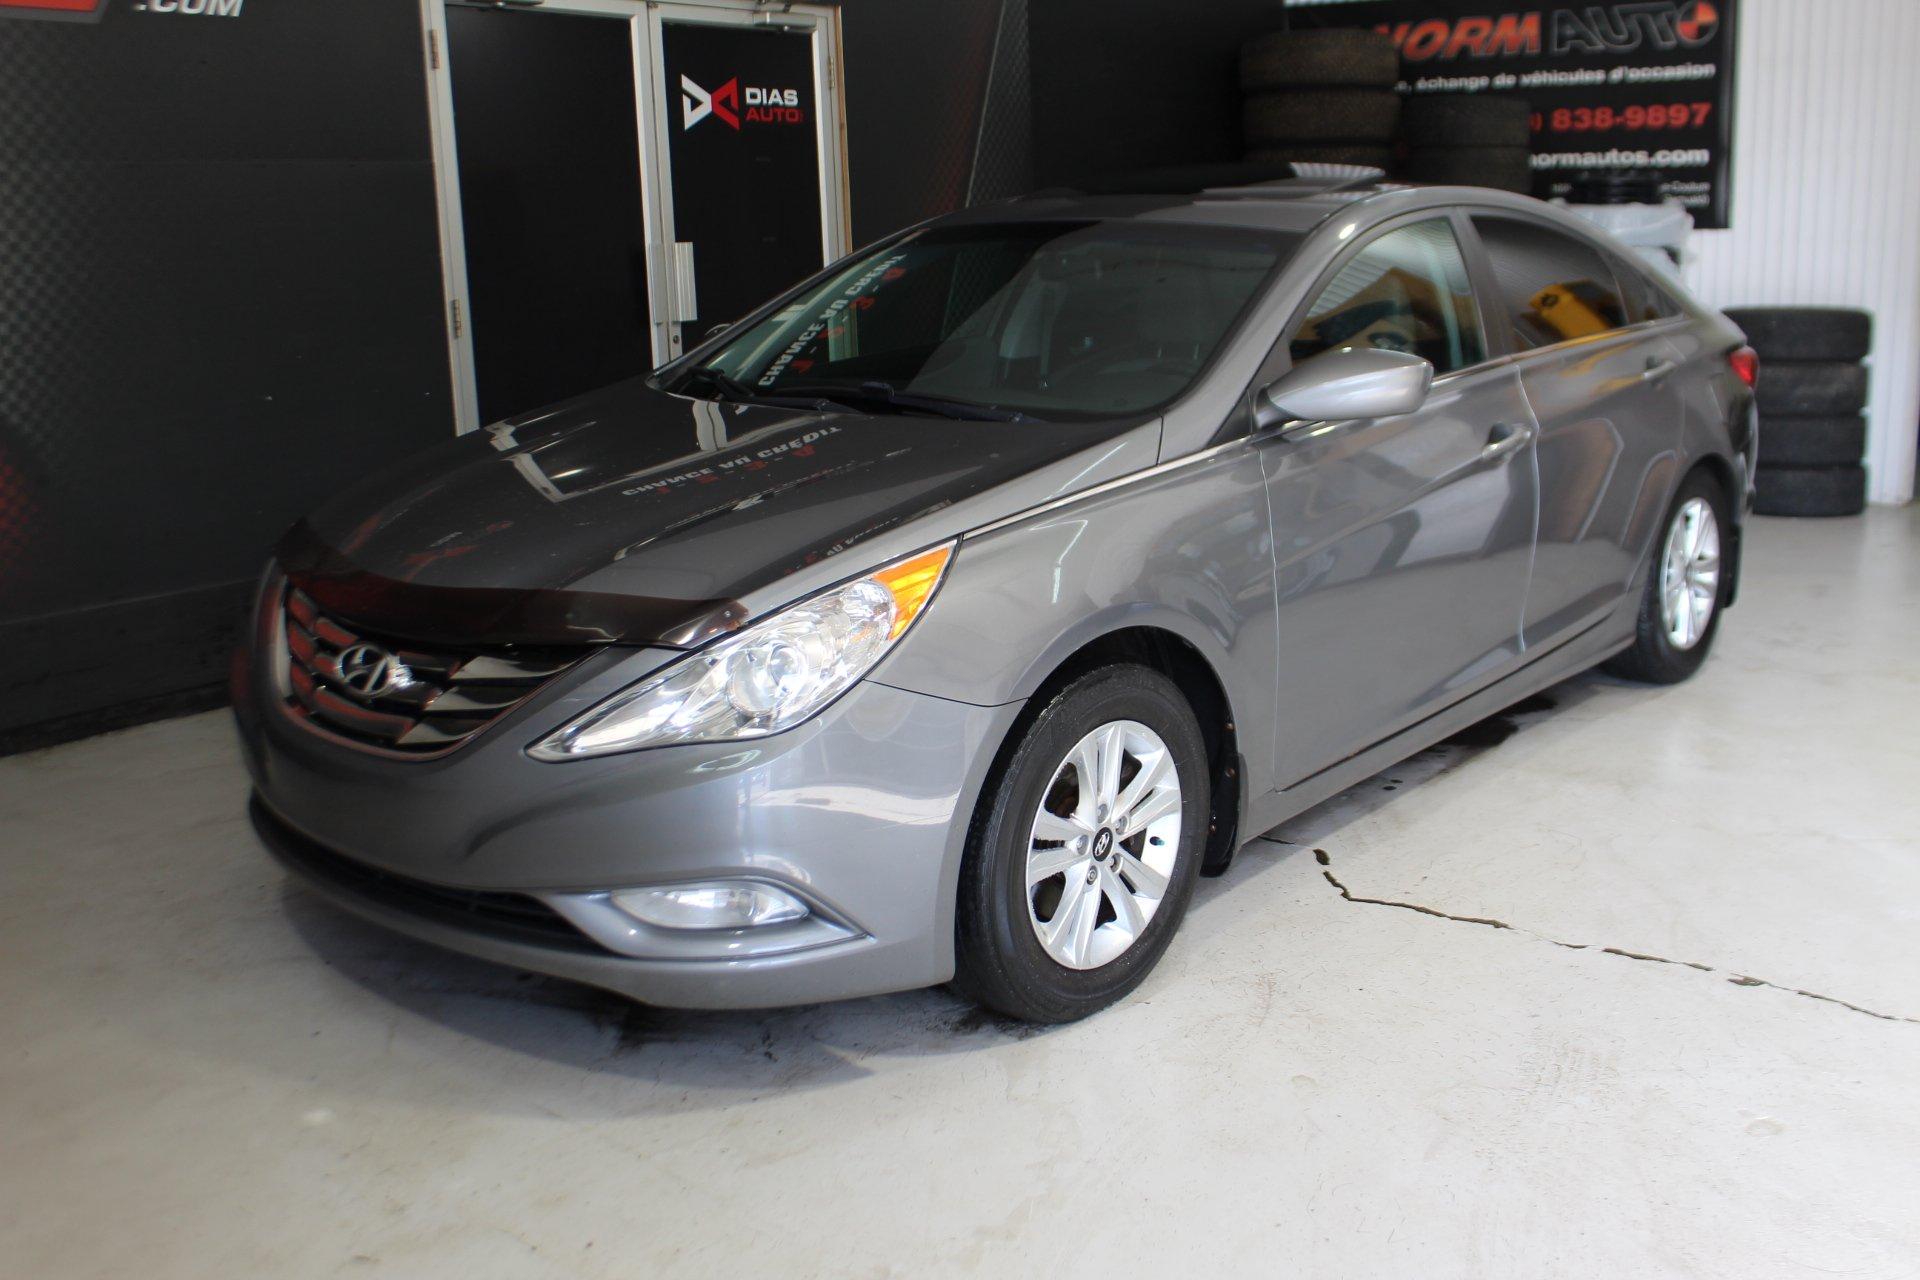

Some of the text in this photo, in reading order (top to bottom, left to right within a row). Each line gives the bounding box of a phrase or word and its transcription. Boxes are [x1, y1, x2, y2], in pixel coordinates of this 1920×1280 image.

[1552, 1, 1719, 52] AUTO
[1416, 76, 1490, 96] échange
[1492, 72, 1517, 90] de
[1519, 68, 1606, 88] véhicules
[1607, 62, 1717, 85] d'occasion
[745, 87, 799, 107] DIAS
[745, 107, 801, 122] AUTO
[1552, 102, 1712, 131] 838-9897
